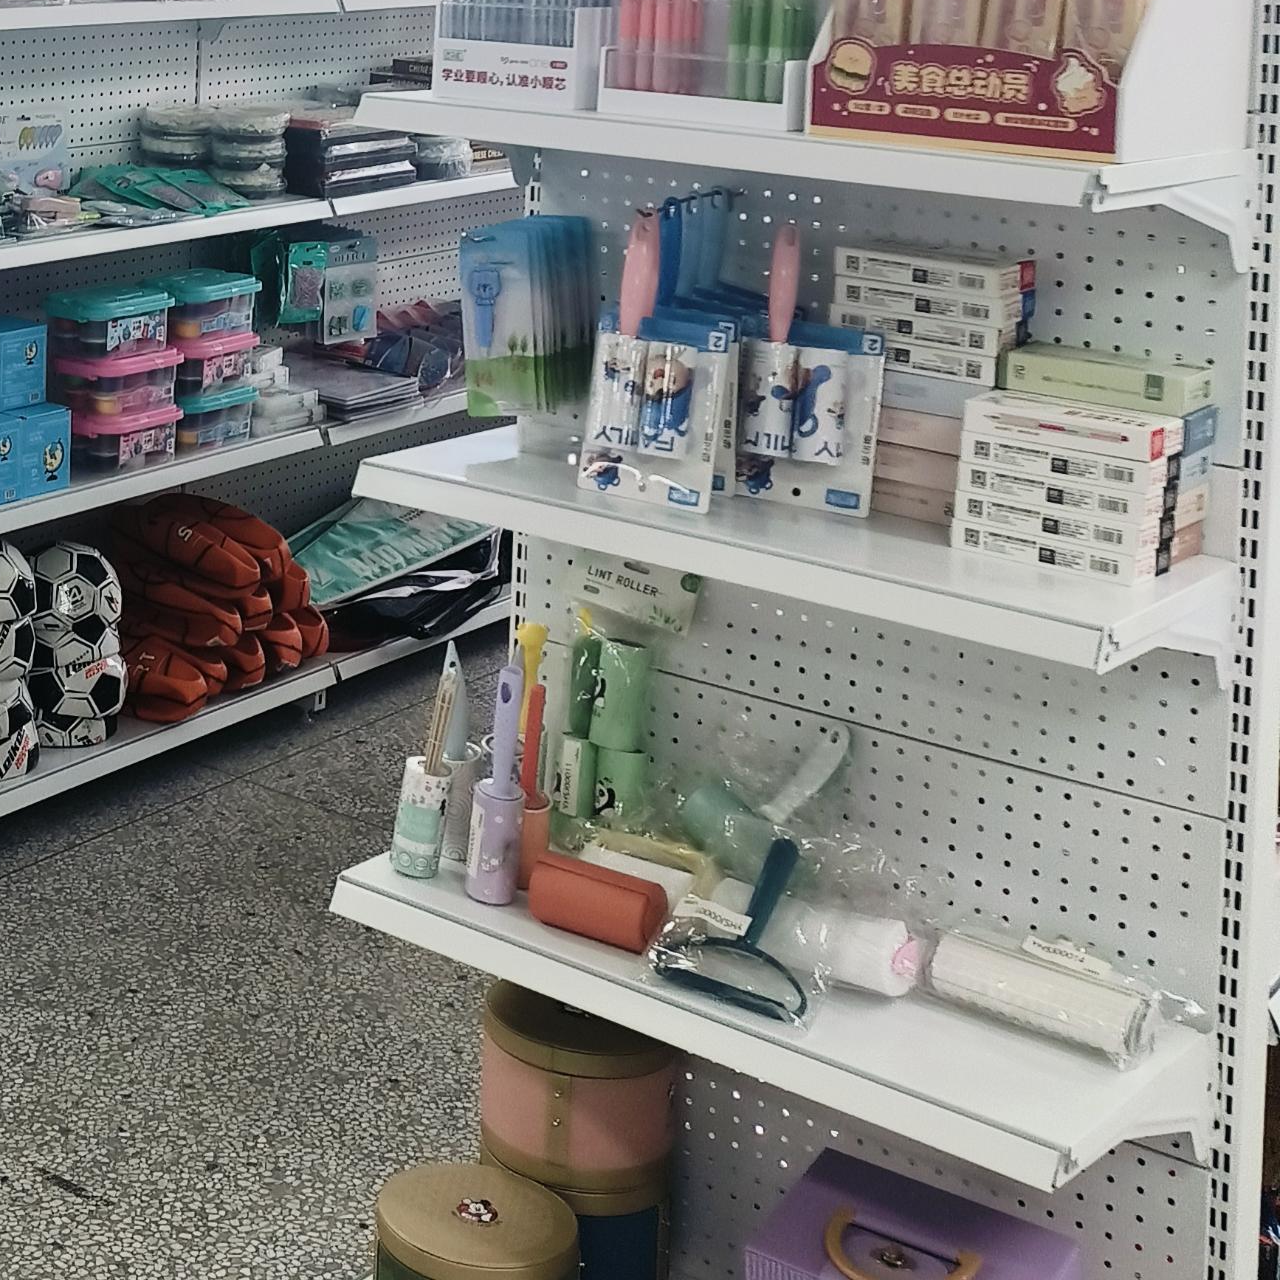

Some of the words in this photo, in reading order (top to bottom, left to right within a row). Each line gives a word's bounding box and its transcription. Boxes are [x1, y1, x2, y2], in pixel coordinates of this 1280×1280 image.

[892, 61, 1033, 104] 美食总动员
[588, 565, 613, 582] LINT
[616, 575, 659, 597] ROLLER
